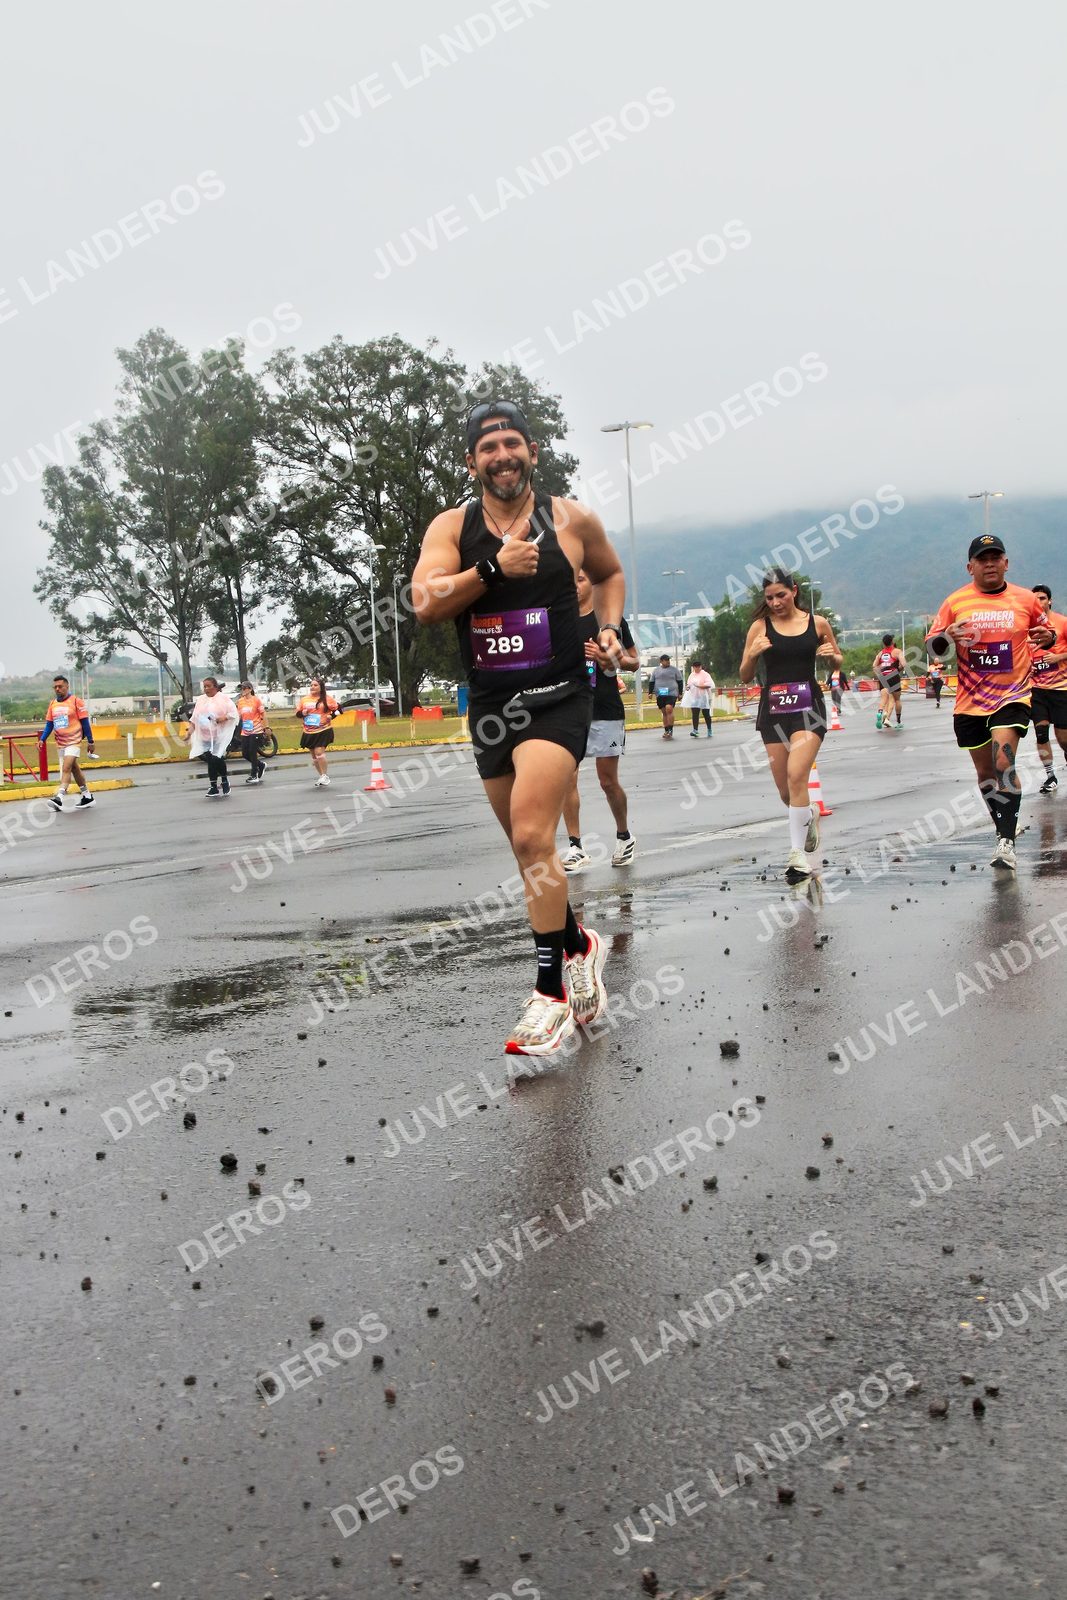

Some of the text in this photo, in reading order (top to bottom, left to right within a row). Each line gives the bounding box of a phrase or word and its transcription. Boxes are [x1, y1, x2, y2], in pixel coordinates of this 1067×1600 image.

[526, 612, 541, 625] 16K
[971, 611, 1014, 622] CARRERA
[972, 621, 1005, 629] OMNILIFE
[486, 635, 524, 654] 289
[979, 655, 999, 665] 143
[779, 695, 798, 705] 247
